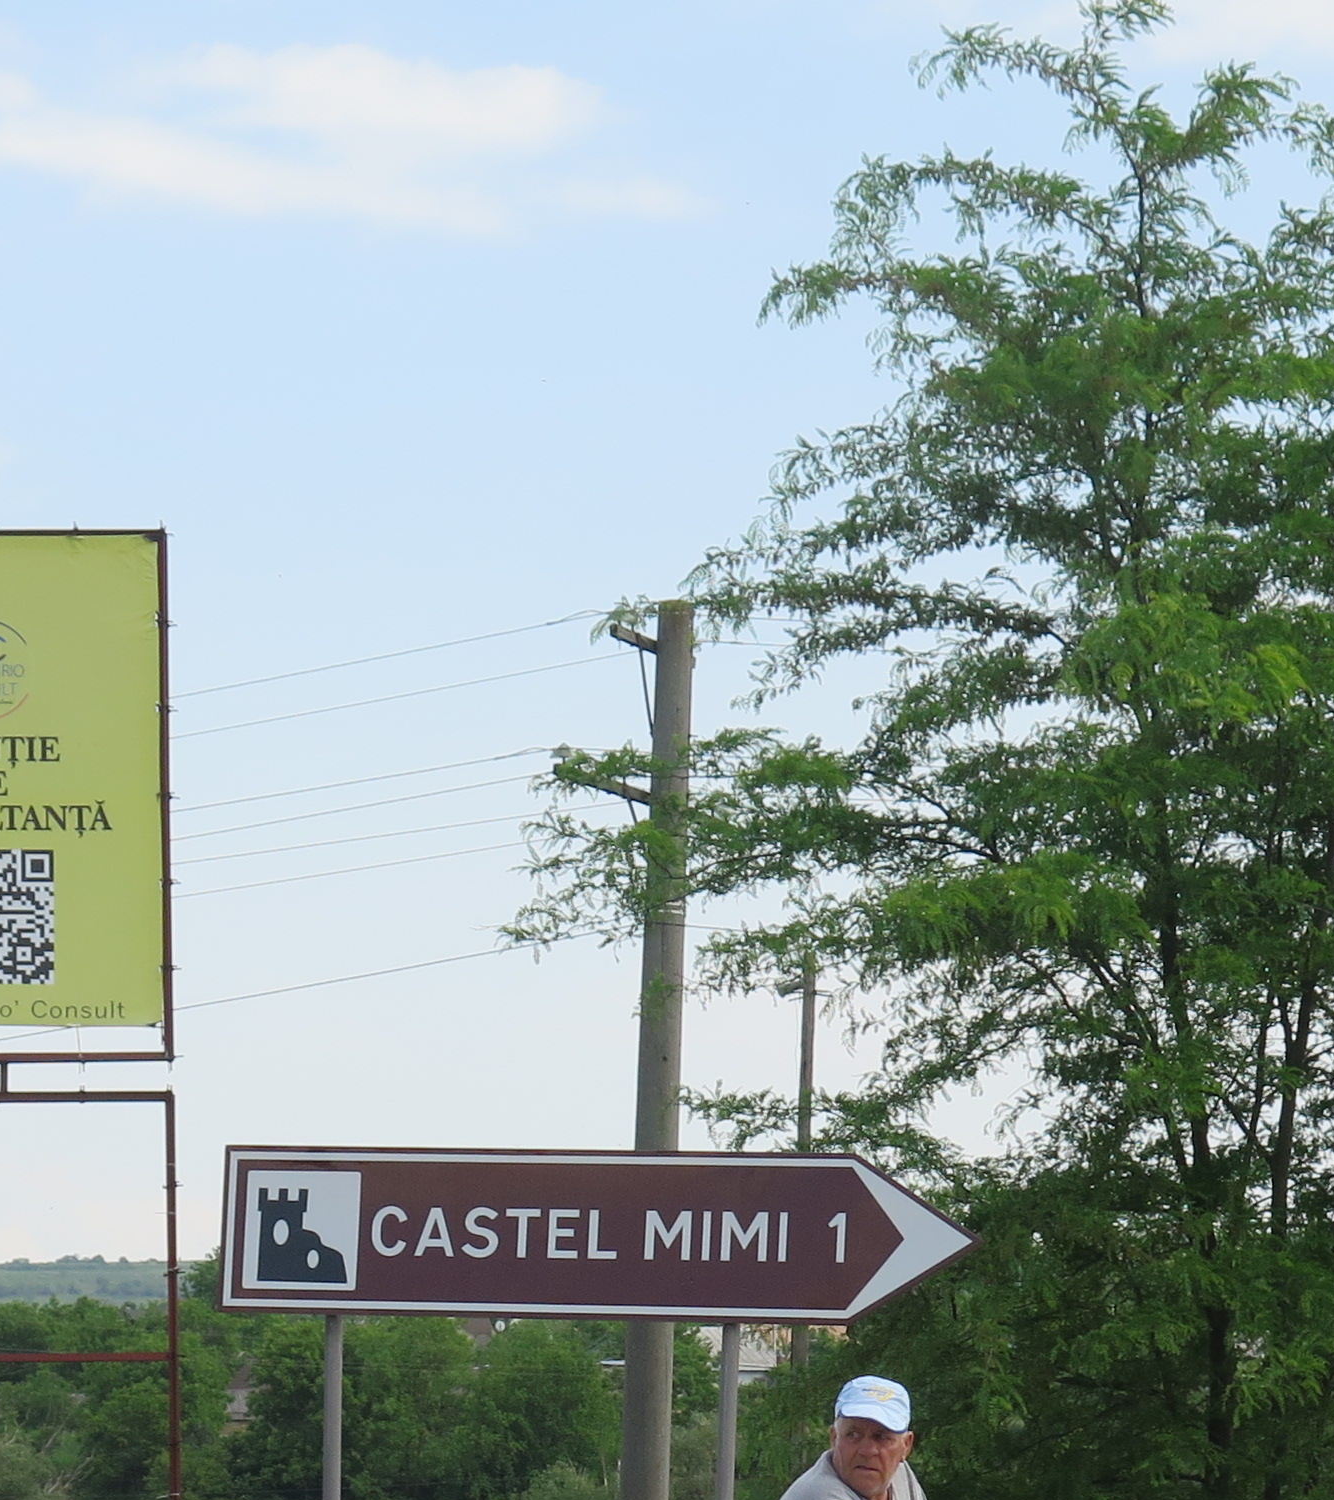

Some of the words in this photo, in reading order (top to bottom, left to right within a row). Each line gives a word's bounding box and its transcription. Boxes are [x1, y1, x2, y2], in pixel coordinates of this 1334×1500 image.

[31, 1000, 126, 1020] Consult
[371, 1205, 617, 1260] CASTEL
[643, 1210, 789, 1262] MIMI
[827, 1212, 848, 1264] 1
